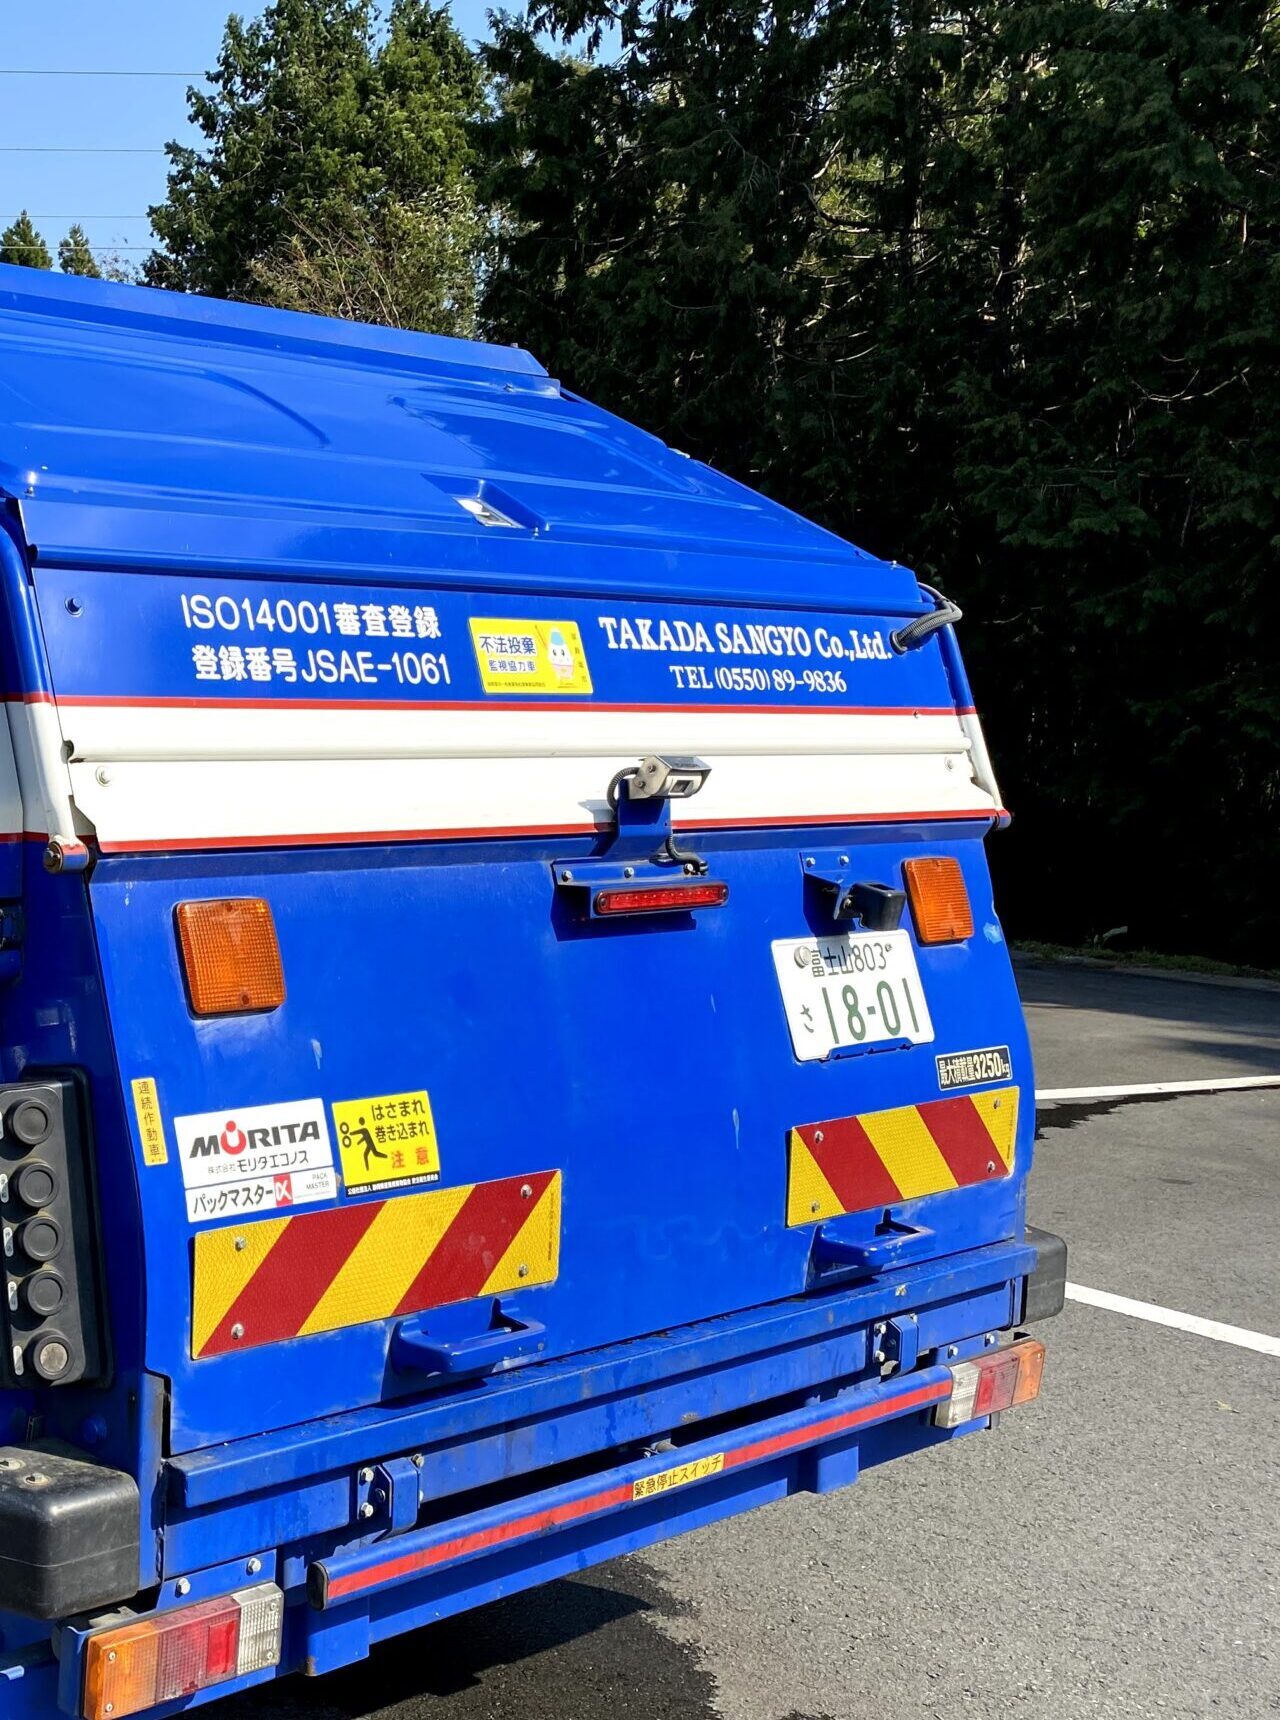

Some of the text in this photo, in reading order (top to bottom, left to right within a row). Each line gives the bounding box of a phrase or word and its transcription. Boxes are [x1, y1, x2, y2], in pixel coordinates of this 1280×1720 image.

[479, 635, 536, 654] 不法投棄
[598, 616, 715, 653] TAKADA
[715, 622, 812, 657] SANGYO
[799, 977, 921, 1045] さ 18-01
[138, 1081, 161, 1158] 連続作動車
[371, 1098, 426, 1122] はさまれ
[189, 1120, 321, 1159] MORITA
[374, 1119, 430, 1144] 巻き込まれ
[305, 1181, 331, 1191] MASTER
[312, 1173, 329, 1181] PACK
[634, 1454, 722, 1498] 緊急停止スイッチ
